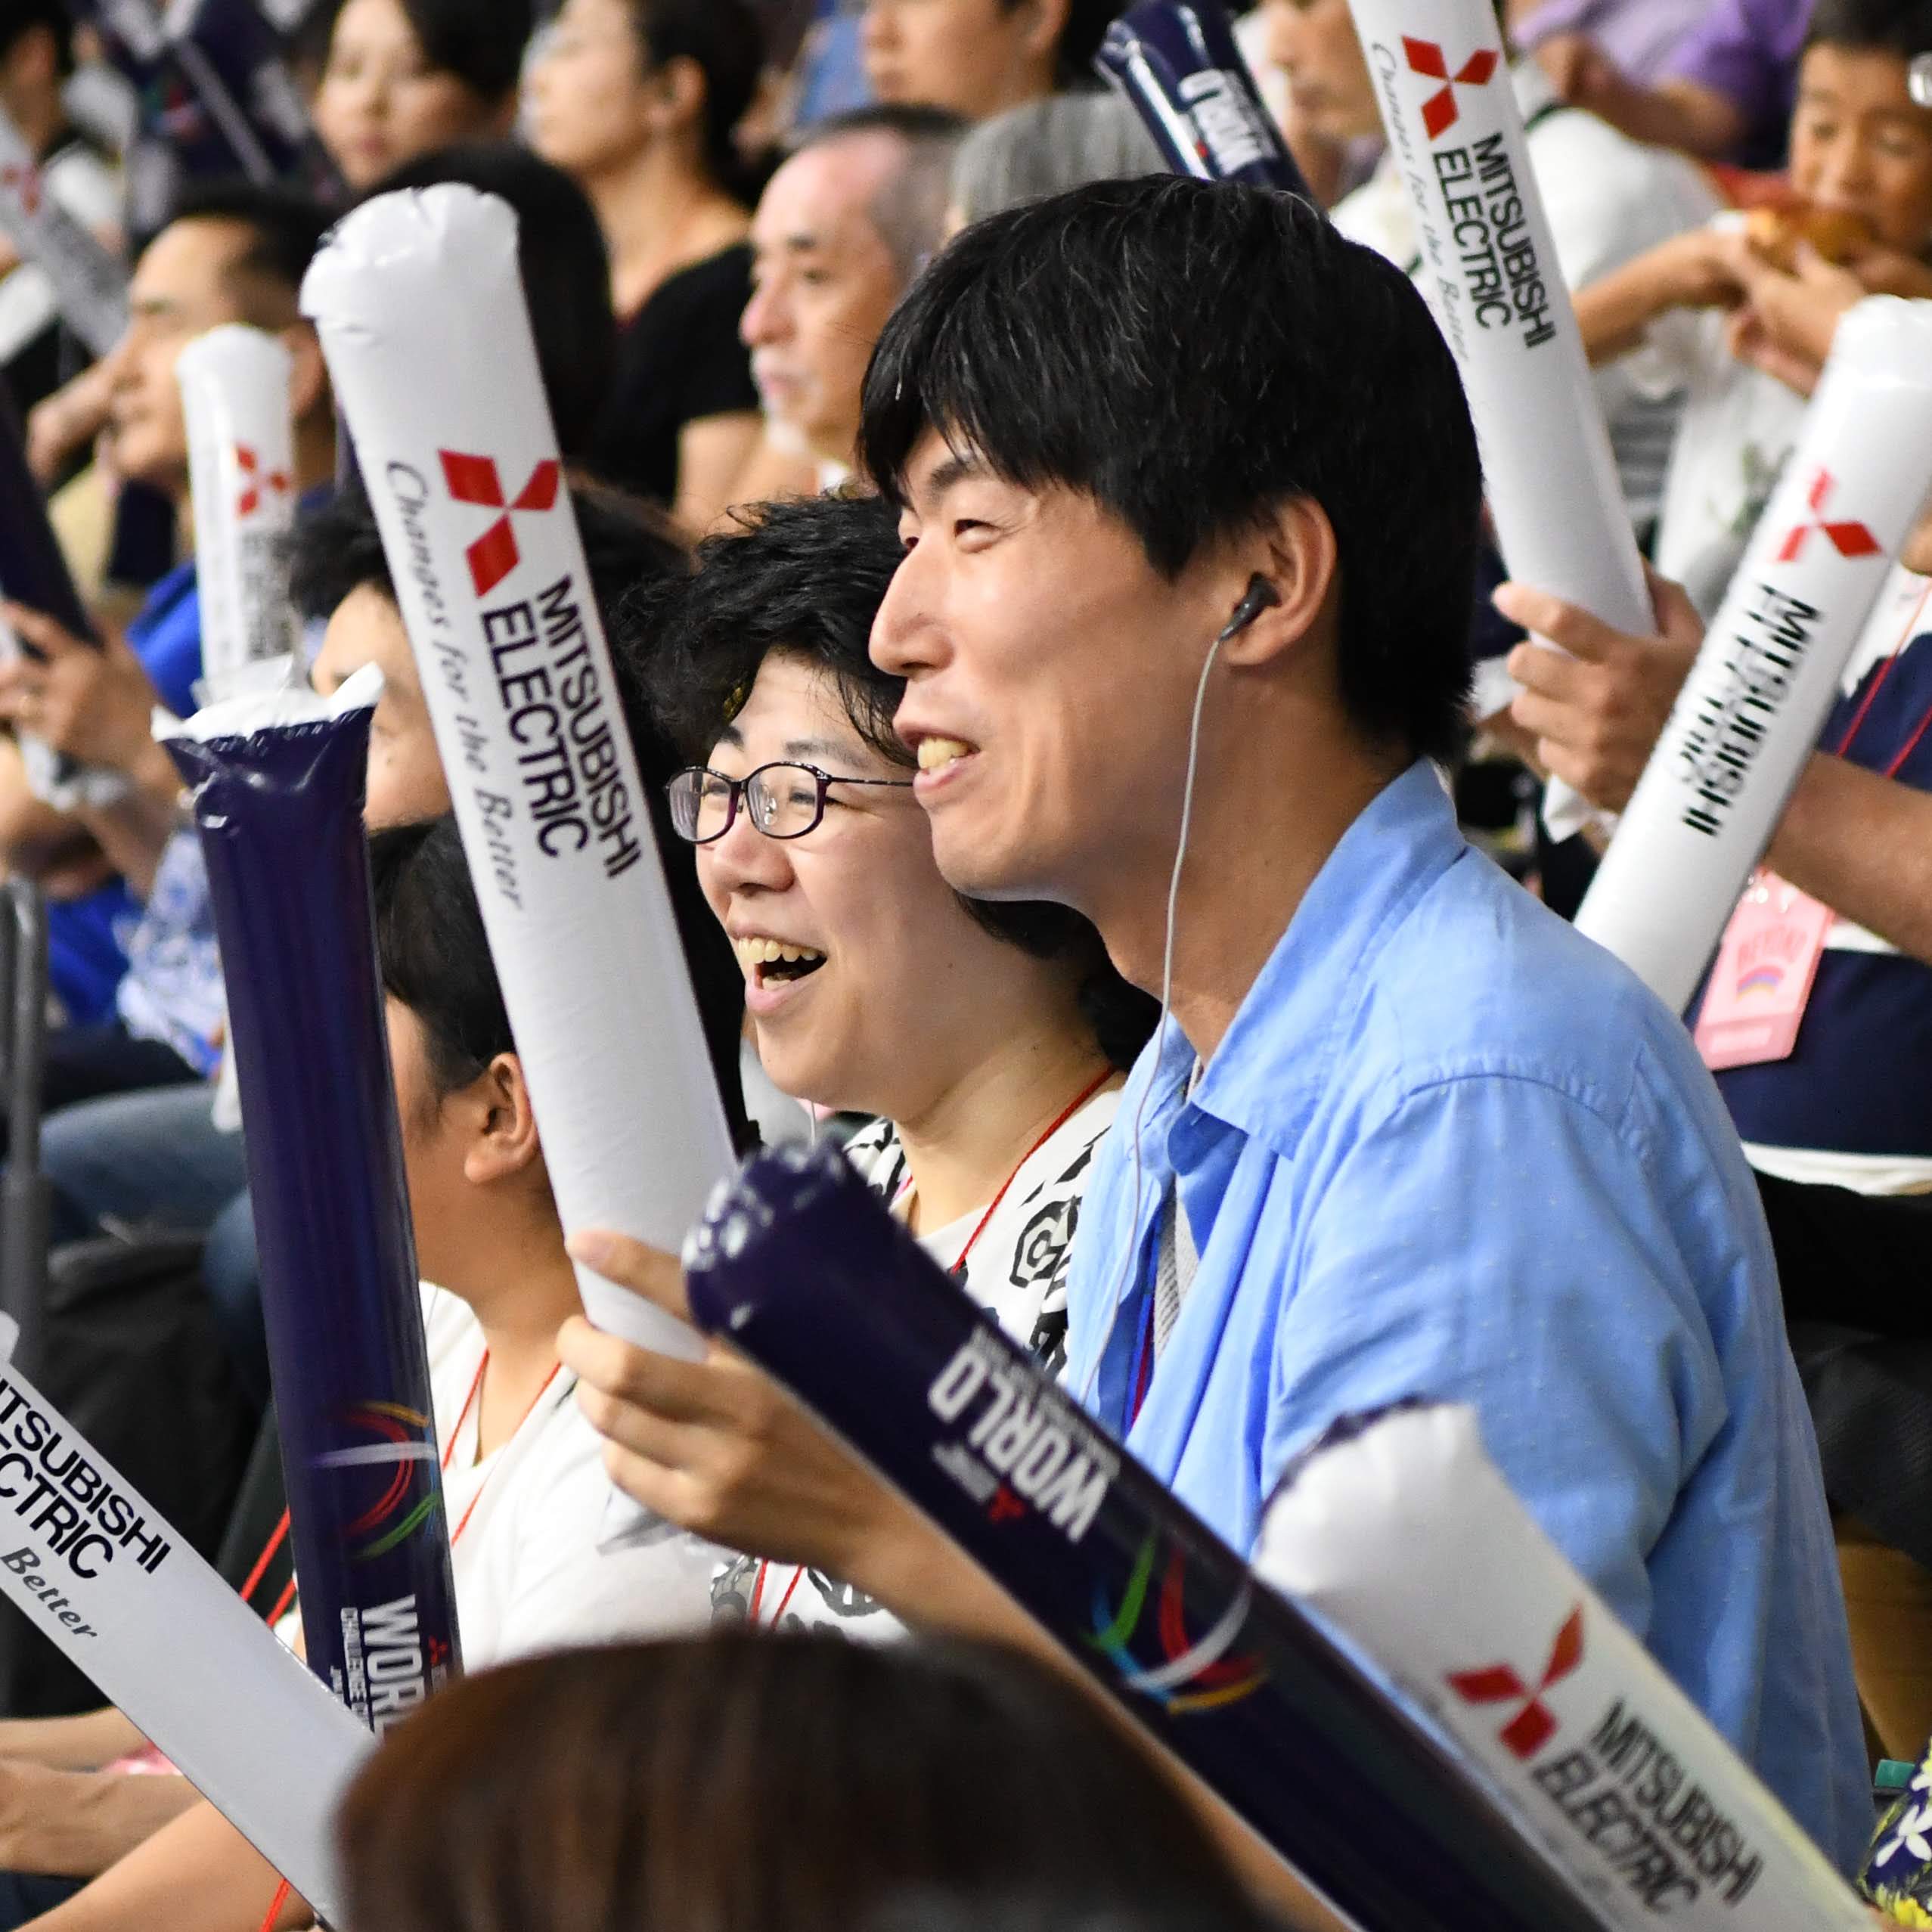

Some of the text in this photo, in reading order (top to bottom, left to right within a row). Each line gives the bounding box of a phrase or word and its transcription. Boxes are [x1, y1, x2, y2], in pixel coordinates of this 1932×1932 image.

[1433, 147, 1510, 329] ELECTRIC
[1472, 132, 1556, 350] MITSUBISHI
[386, 459, 523, 910] Changes for the Better
[480, 600, 589, 858] ELECTRIC
[538, 575, 642, 879] MITSUBISHI
[928, 1346, 1109, 1543] WORLD
[0, 1547, 98, 1638] Better
[1530, 1748, 1700, 1915] ELECTRIC
[1594, 1698, 1764, 1909] MITSUBISHI
